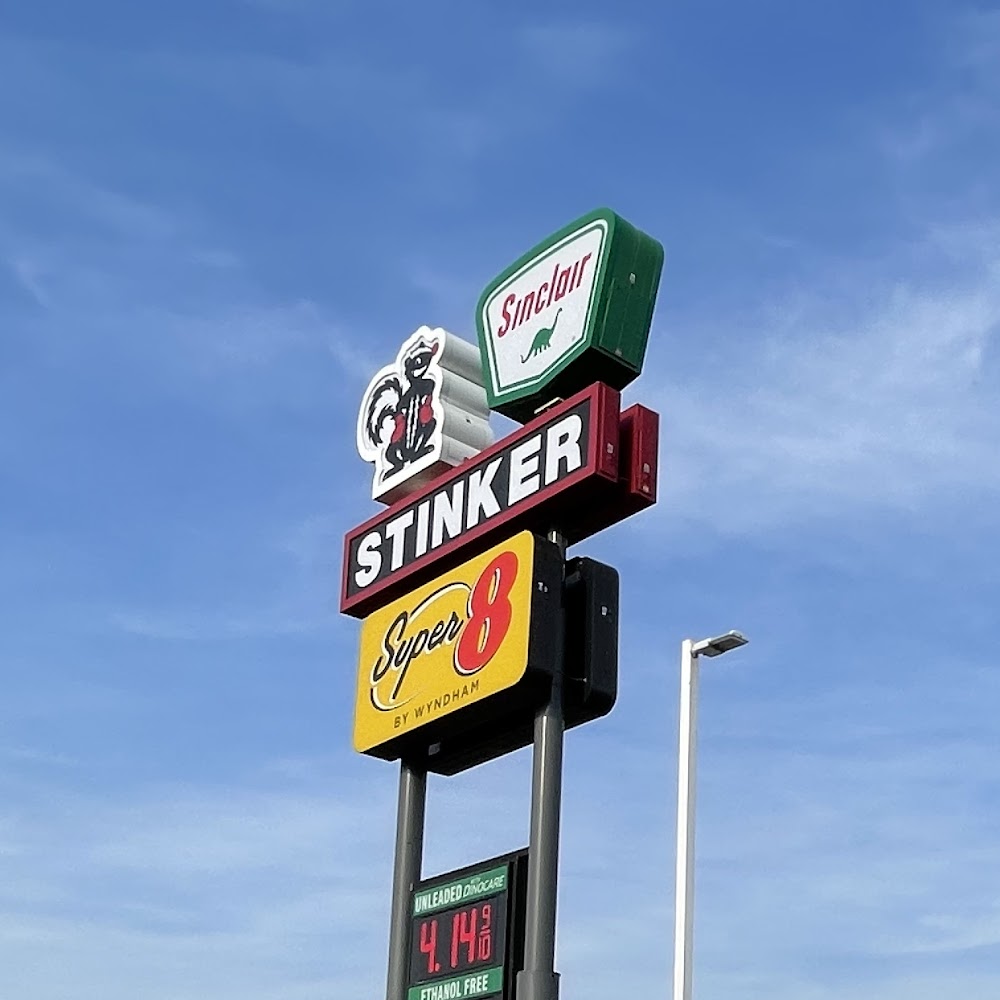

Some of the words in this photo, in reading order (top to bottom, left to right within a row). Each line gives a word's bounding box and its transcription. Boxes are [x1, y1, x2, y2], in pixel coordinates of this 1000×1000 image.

[497, 252, 592, 338] Sinclair
[355, 413, 583, 587] STINKER
[370, 611, 465, 703] Super
[454, 550, 519, 676] 8
[393, 712, 410, 729] BY
[414, 679, 480, 719] WYNDHAM
[415, 884, 463, 913] UNLEADED
[463, 875, 505, 898] DINOCARE
[463, 974, 489, 996] FREE
